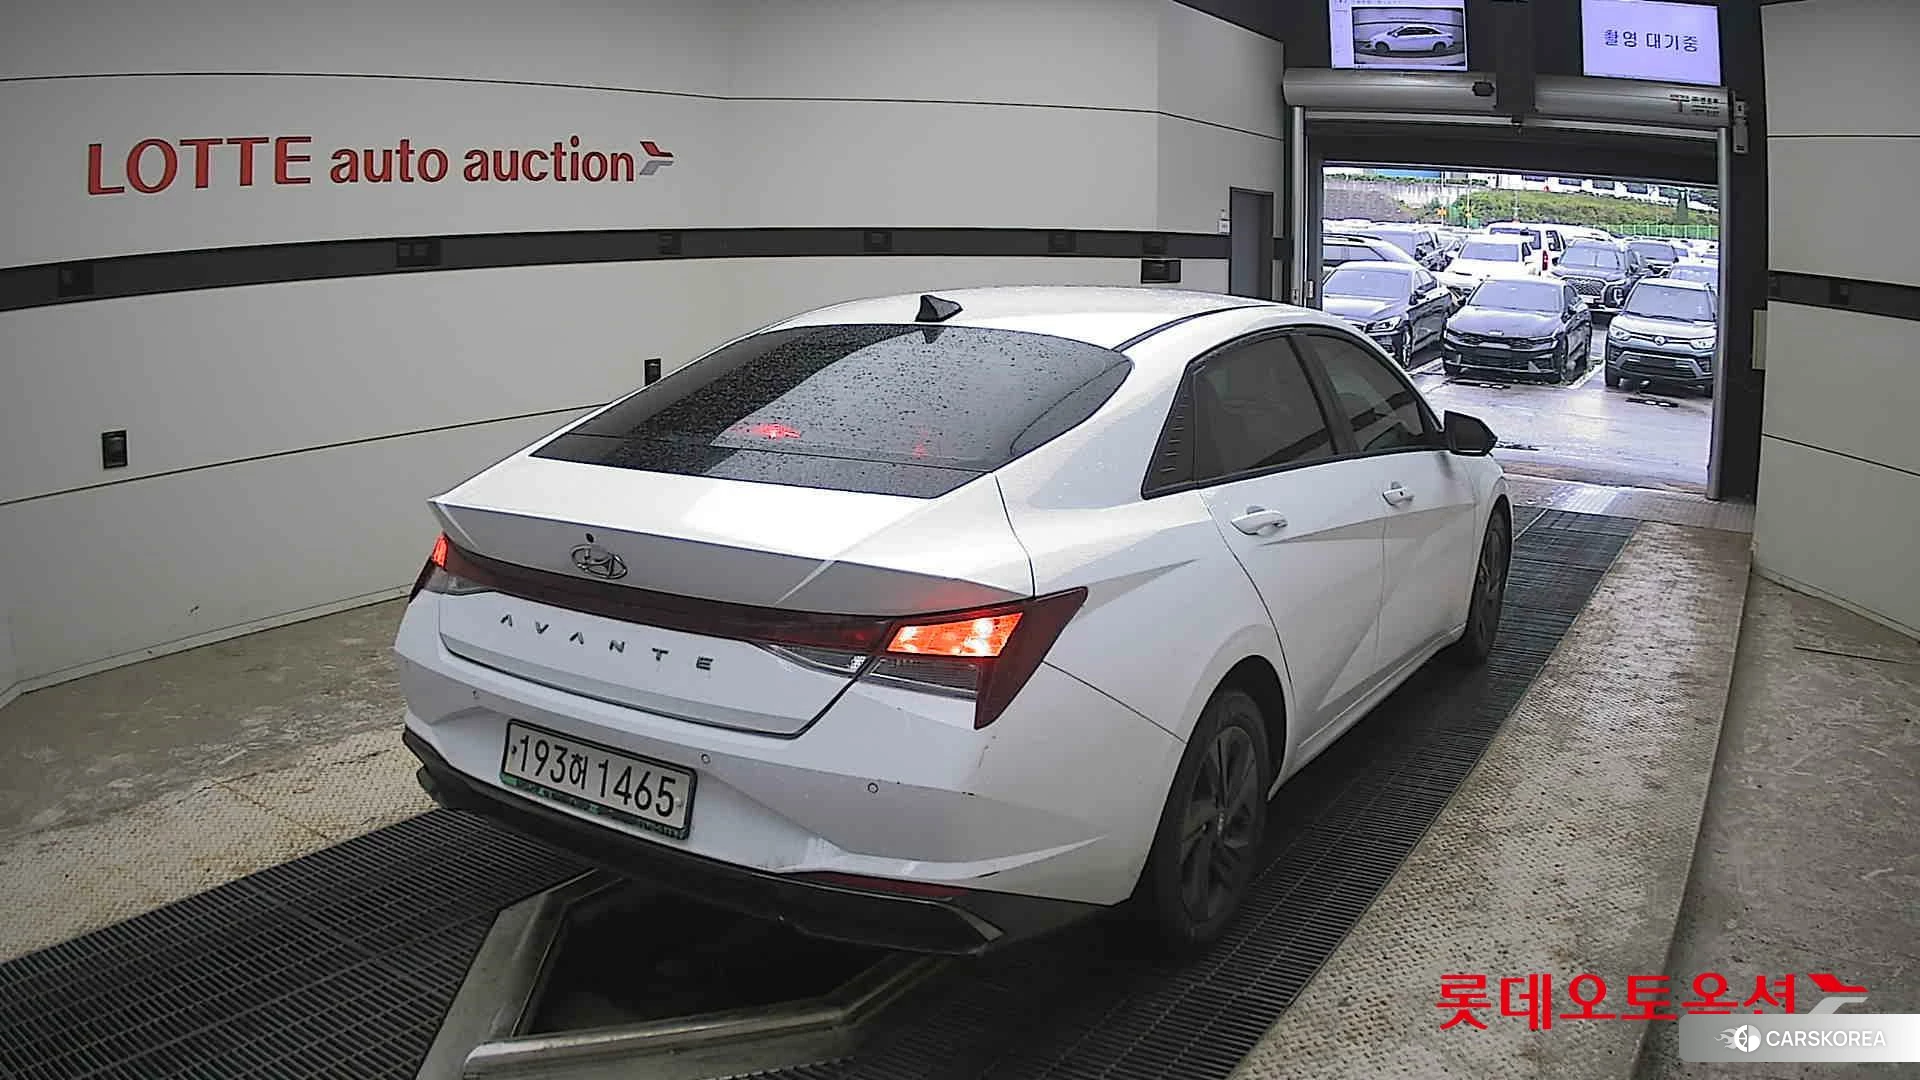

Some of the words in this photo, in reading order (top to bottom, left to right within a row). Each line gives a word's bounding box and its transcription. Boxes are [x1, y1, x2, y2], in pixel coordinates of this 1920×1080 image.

[1645, 32, 1698, 53] 대기중
[87, 135, 312, 195] LOTTE
[329, 138, 449, 184] auto
[463, 135, 635, 183] auction
[500, 613, 714, 671] AVANTE
[519, 735, 589, 790] 193허
[598, 759, 677, 817] 1465
